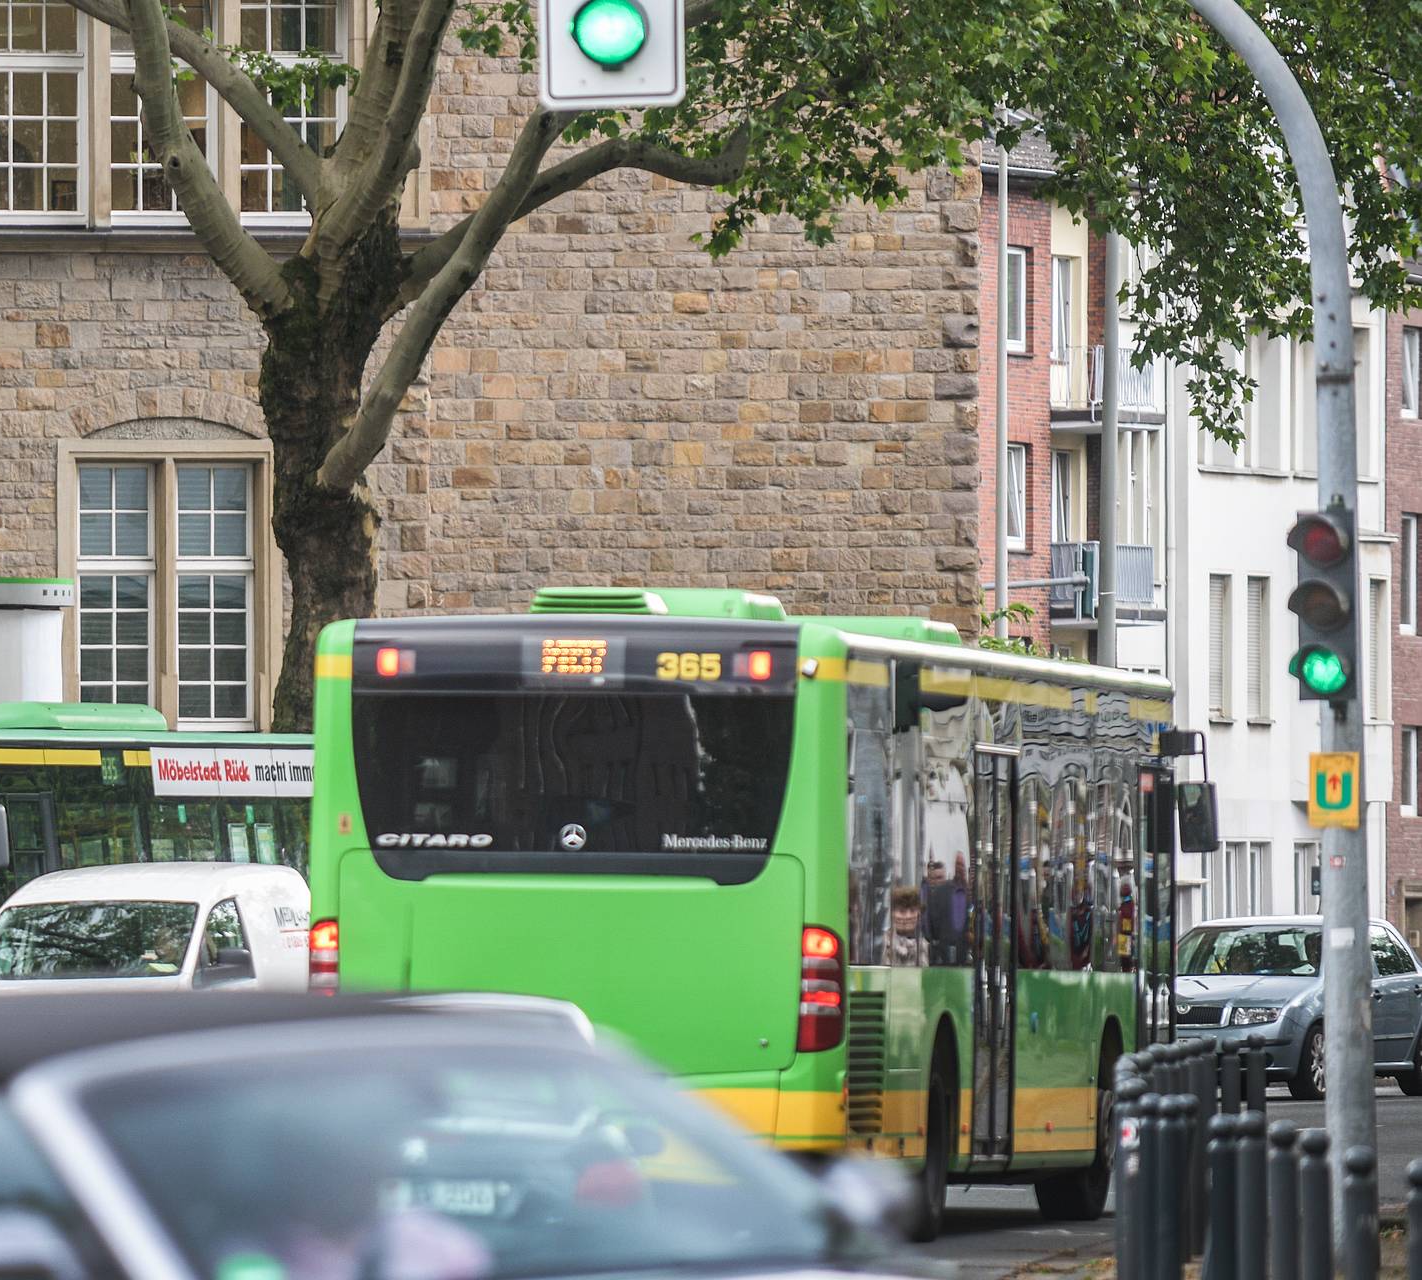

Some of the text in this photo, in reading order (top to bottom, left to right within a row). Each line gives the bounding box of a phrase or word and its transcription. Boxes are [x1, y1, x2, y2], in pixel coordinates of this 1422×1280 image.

[655, 652, 722, 681] 365
[157, 758, 222, 782] Möbelstadt
[255, 759, 287, 782] macht
[1316, 771, 1352, 810] U
[376, 832, 493, 848] CITARO
[661, 833, 769, 850] Mercedes-Benz
